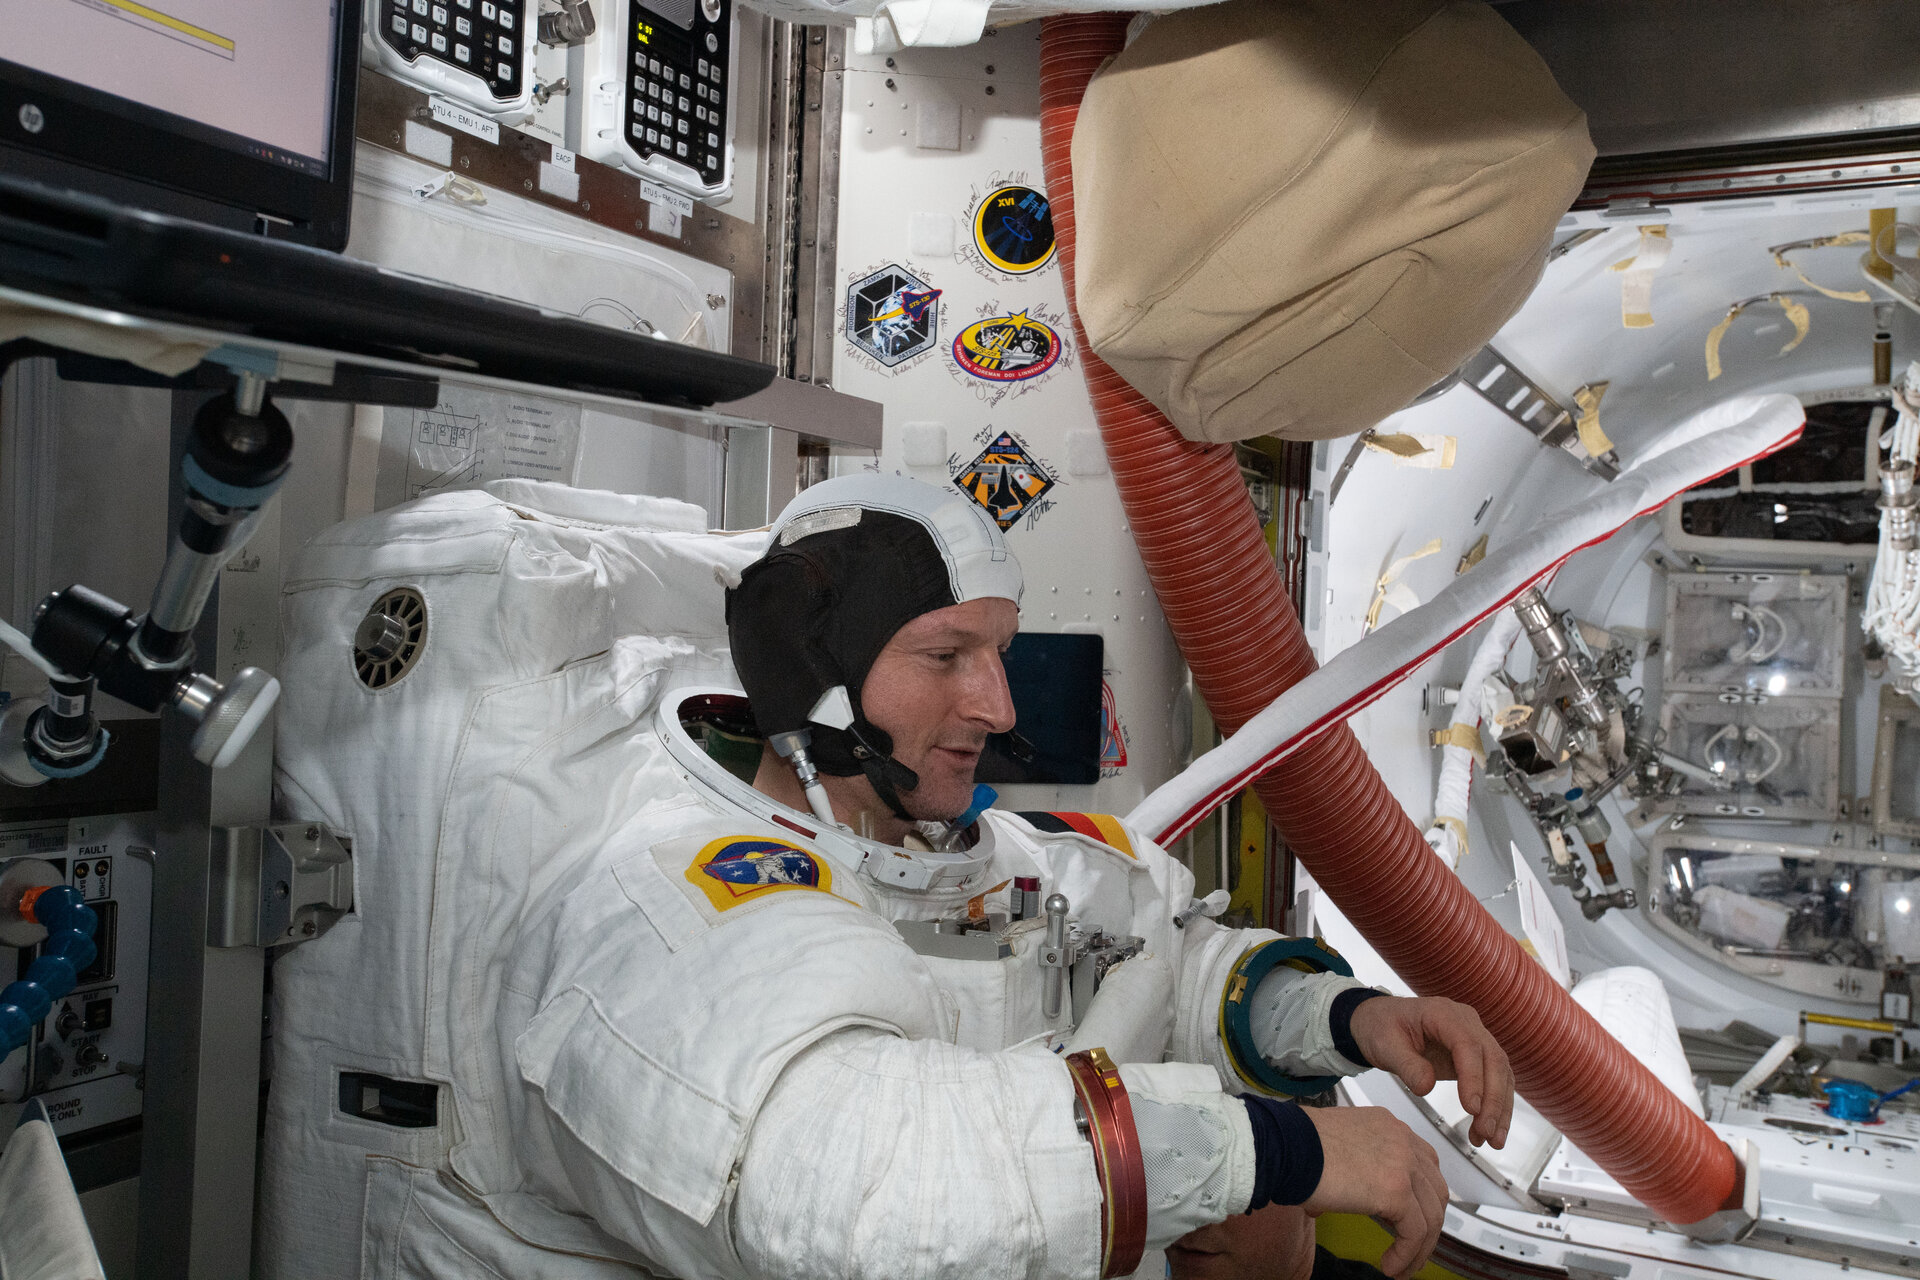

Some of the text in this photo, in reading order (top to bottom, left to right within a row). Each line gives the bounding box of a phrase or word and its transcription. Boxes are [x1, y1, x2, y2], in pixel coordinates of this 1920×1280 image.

[432, 105, 446, 116] ATU
[446, 110, 451, 118] 4
[458, 115, 474, 127] EMU
[481, 124, 494, 135] AFT
[556, 152, 571, 163] EACP
[644, 187, 653, 196] ATU
[997, 198, 1015, 207] XVI
[863, 272, 885, 286] ZAMKA
[905, 275, 922, 288] VIRTS
[909, 295, 930, 308] STS-130
[856, 338, 884, 360] BEHNKEN
[898, 345, 923, 360] PATRICK
[956, 345, 972, 368] BEHNKEN
[974, 367, 1000, 377] FOREMAN
[1018, 364, 1046, 377] LINNEHAN
[1046, 340, 1057, 363] REISMAN
[974, 453, 987, 465] KELLY
[1021, 453, 1032, 464] HAM
[959, 483, 976, 501] FOSSUM
[1020, 493, 1042, 515] CHAMITOFF
[80, 828, 84, 836] 1
[79, 845, 108, 855] FAULT
[72, 1035, 100, 1047] START
[72, 1065, 97, 1077] STOP
[48, 1099, 80, 1113] ROUND
[57, 1107, 83, 1121] ONLY
